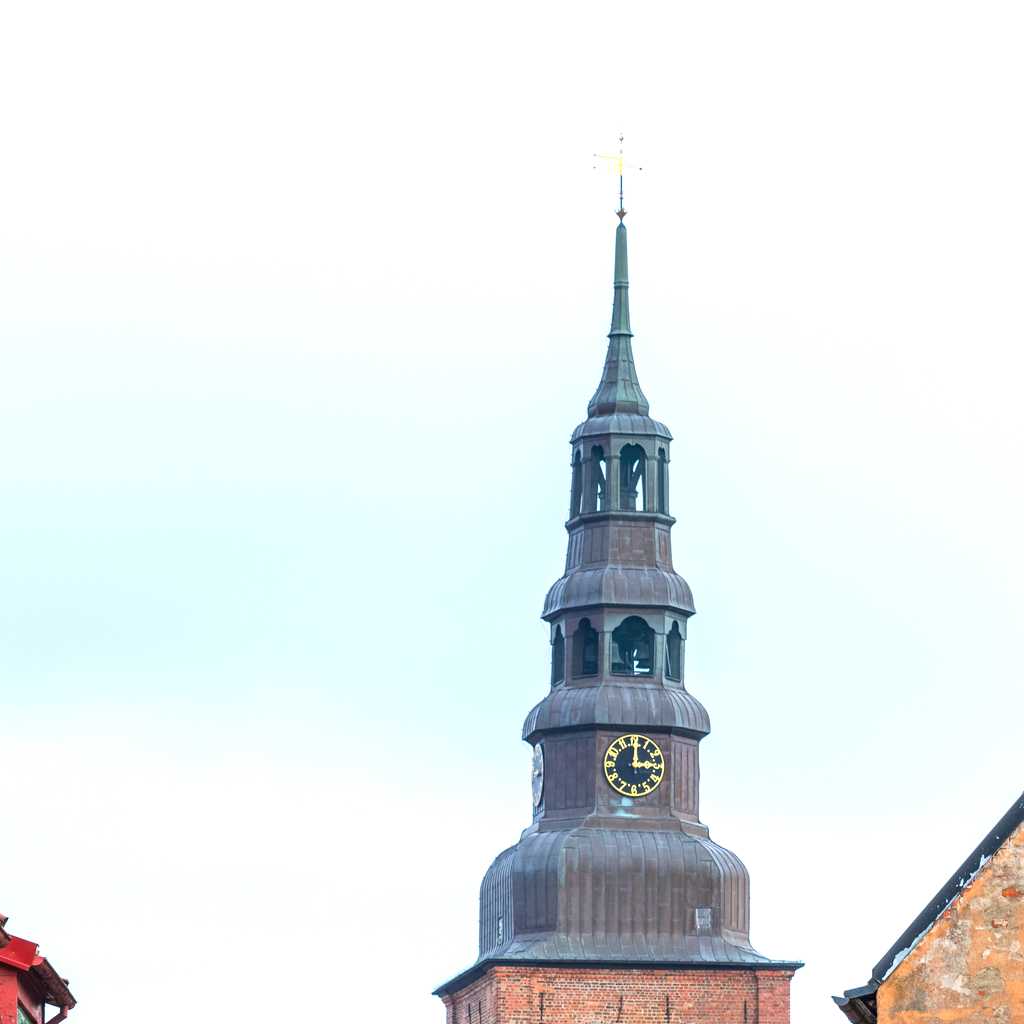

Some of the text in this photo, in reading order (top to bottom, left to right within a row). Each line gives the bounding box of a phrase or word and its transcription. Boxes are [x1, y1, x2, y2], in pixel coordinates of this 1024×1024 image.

[643, 740, 649, 750] 1
[650, 749, 660, 759] 2
[608, 772, 619, 782] 8
[650, 774, 660, 783] 4
[619, 780, 627, 791] 7
[631, 784, 637, 795] 6
[642, 781, 651, 792] 5
